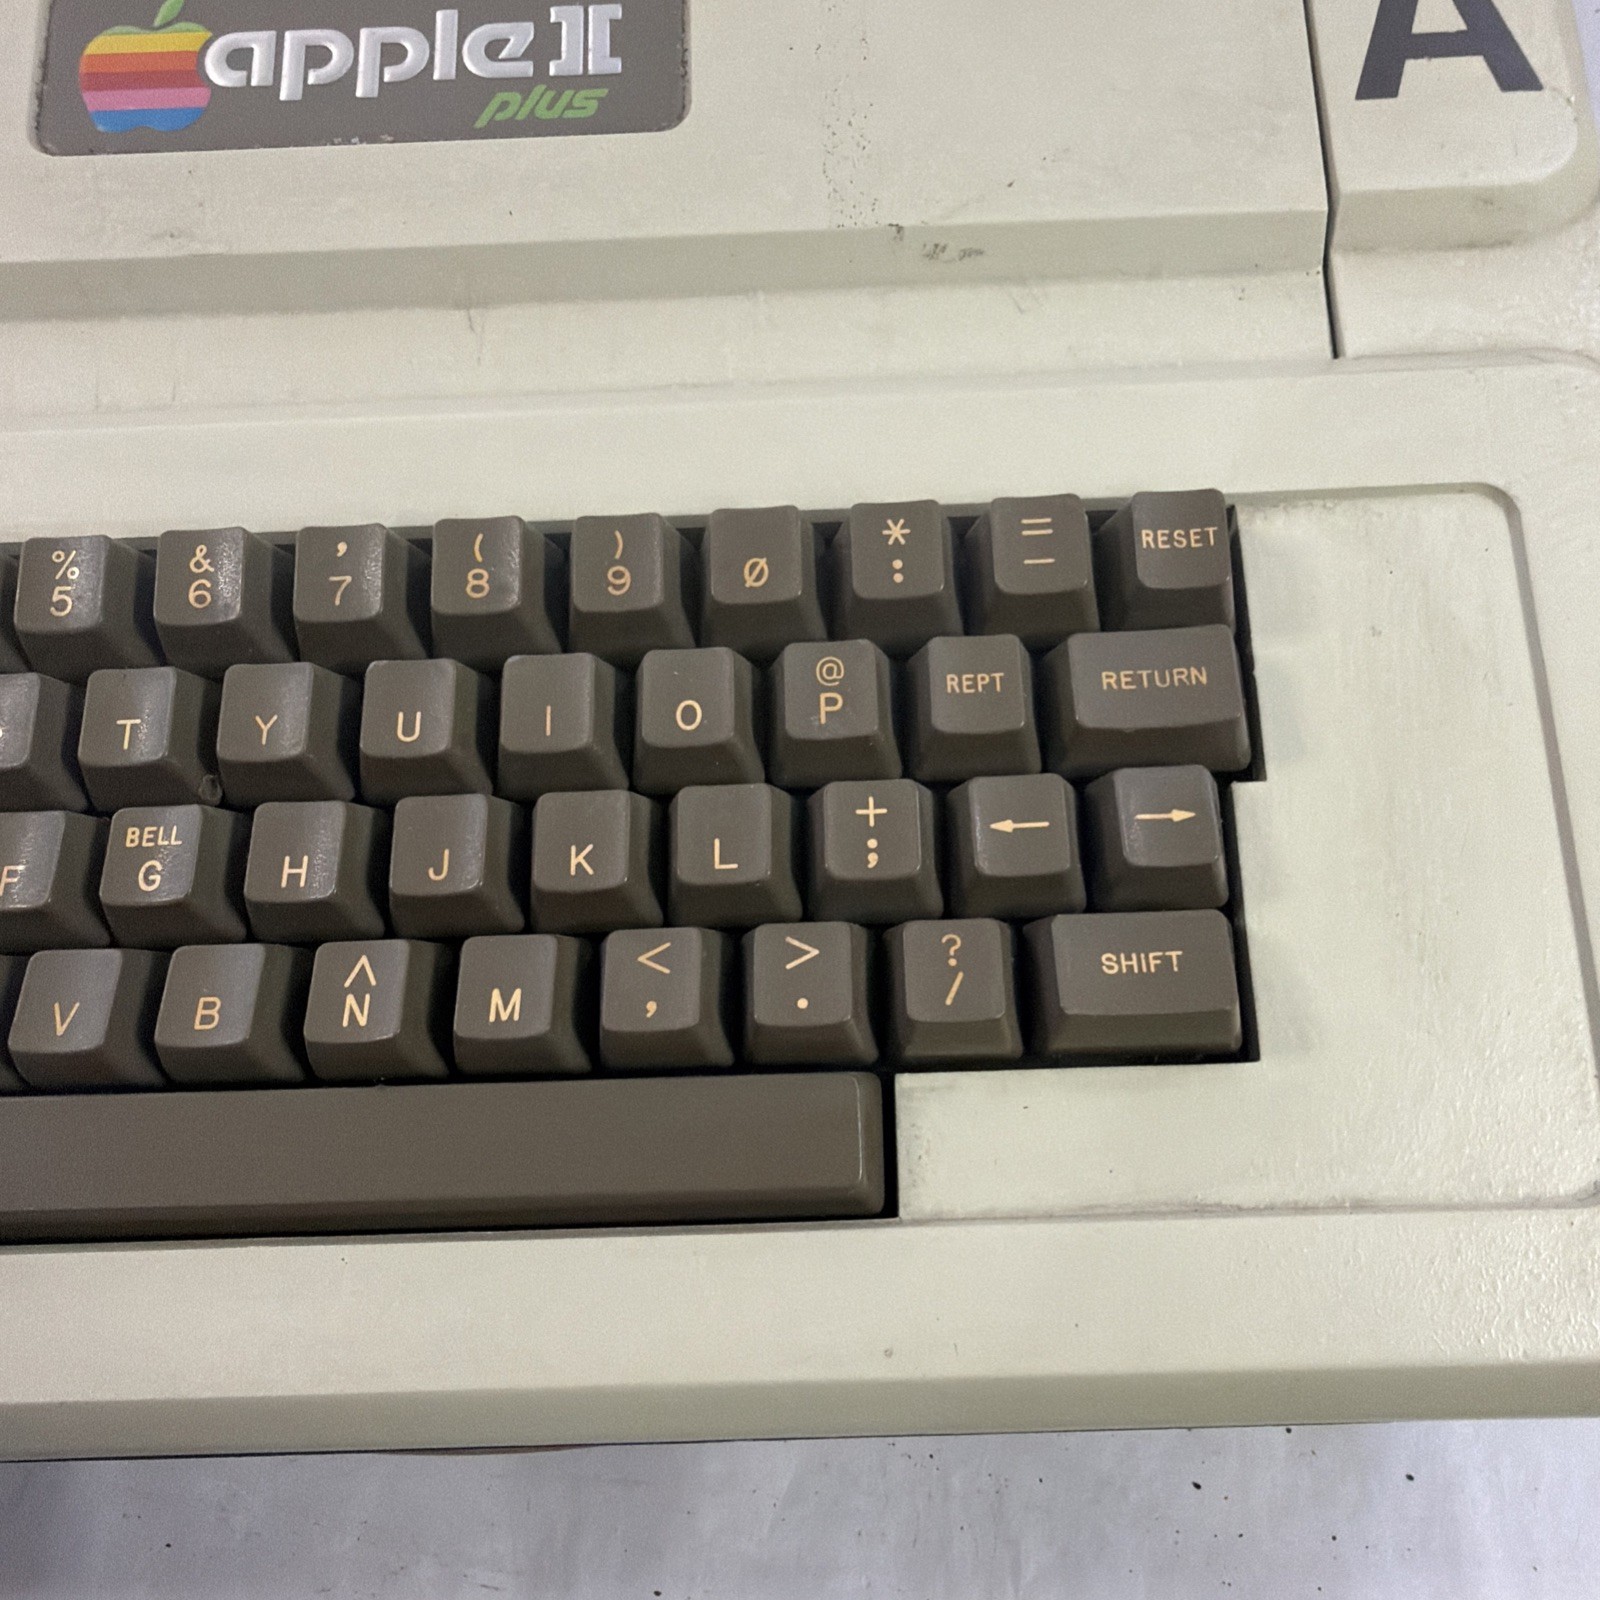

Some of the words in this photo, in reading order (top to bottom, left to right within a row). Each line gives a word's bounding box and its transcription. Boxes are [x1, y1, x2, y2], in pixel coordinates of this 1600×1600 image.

[204, 8, 535, 102] apple
[1355, 0, 1543, 101] A
[474, 84, 611, 130] plus
[1020, 517, 1052, 537] =
[1139, 526, 1217, 551] RESET
[187, 543, 214, 574] &
[472, 534, 484, 564] (
[613, 531, 625, 559] )
[50, 550, 79, 581] %
[606, 565, 632, 596] 9
[890, 559, 904, 584] :
[187, 578, 212, 609] 6
[329, 575, 352, 606] 7
[464, 567, 491, 600] 8
[49, 583, 74, 618] 5
[814, 655, 846, 688] @
[945, 672, 1004, 694] REPT
[1100, 666, 1208, 692] RETURN
[544, 705, 552, 737] I
[674, 699, 703, 732] O
[818, 690, 844, 725] P
[116, 718, 141, 750] T
[252, 715, 277, 745] Y
[394, 711, 421, 744] U
[855, 796, 888, 827] +
[124, 825, 182, 849] BELL
[866, 838, 879, 869] ;
[426, 848, 450, 882] J
[568, 844, 594, 876] K
[712, 838, 738, 871] L
[0, 864, 26, 897] F
[136, 859, 162, 893] G
[279, 855, 309, 889] H
[636, 942, 670, 975] <
[784, 936, 820, 970] >
[941, 933, 962, 968] ?
[1100, 949, 1183, 976] SHIFT
[945, 970, 965, 1006] /
[52, 1001, 81, 1036] V
[192, 995, 222, 1032] B
[341, 994, 371, 1028] N
[487, 987, 522, 1023] M
